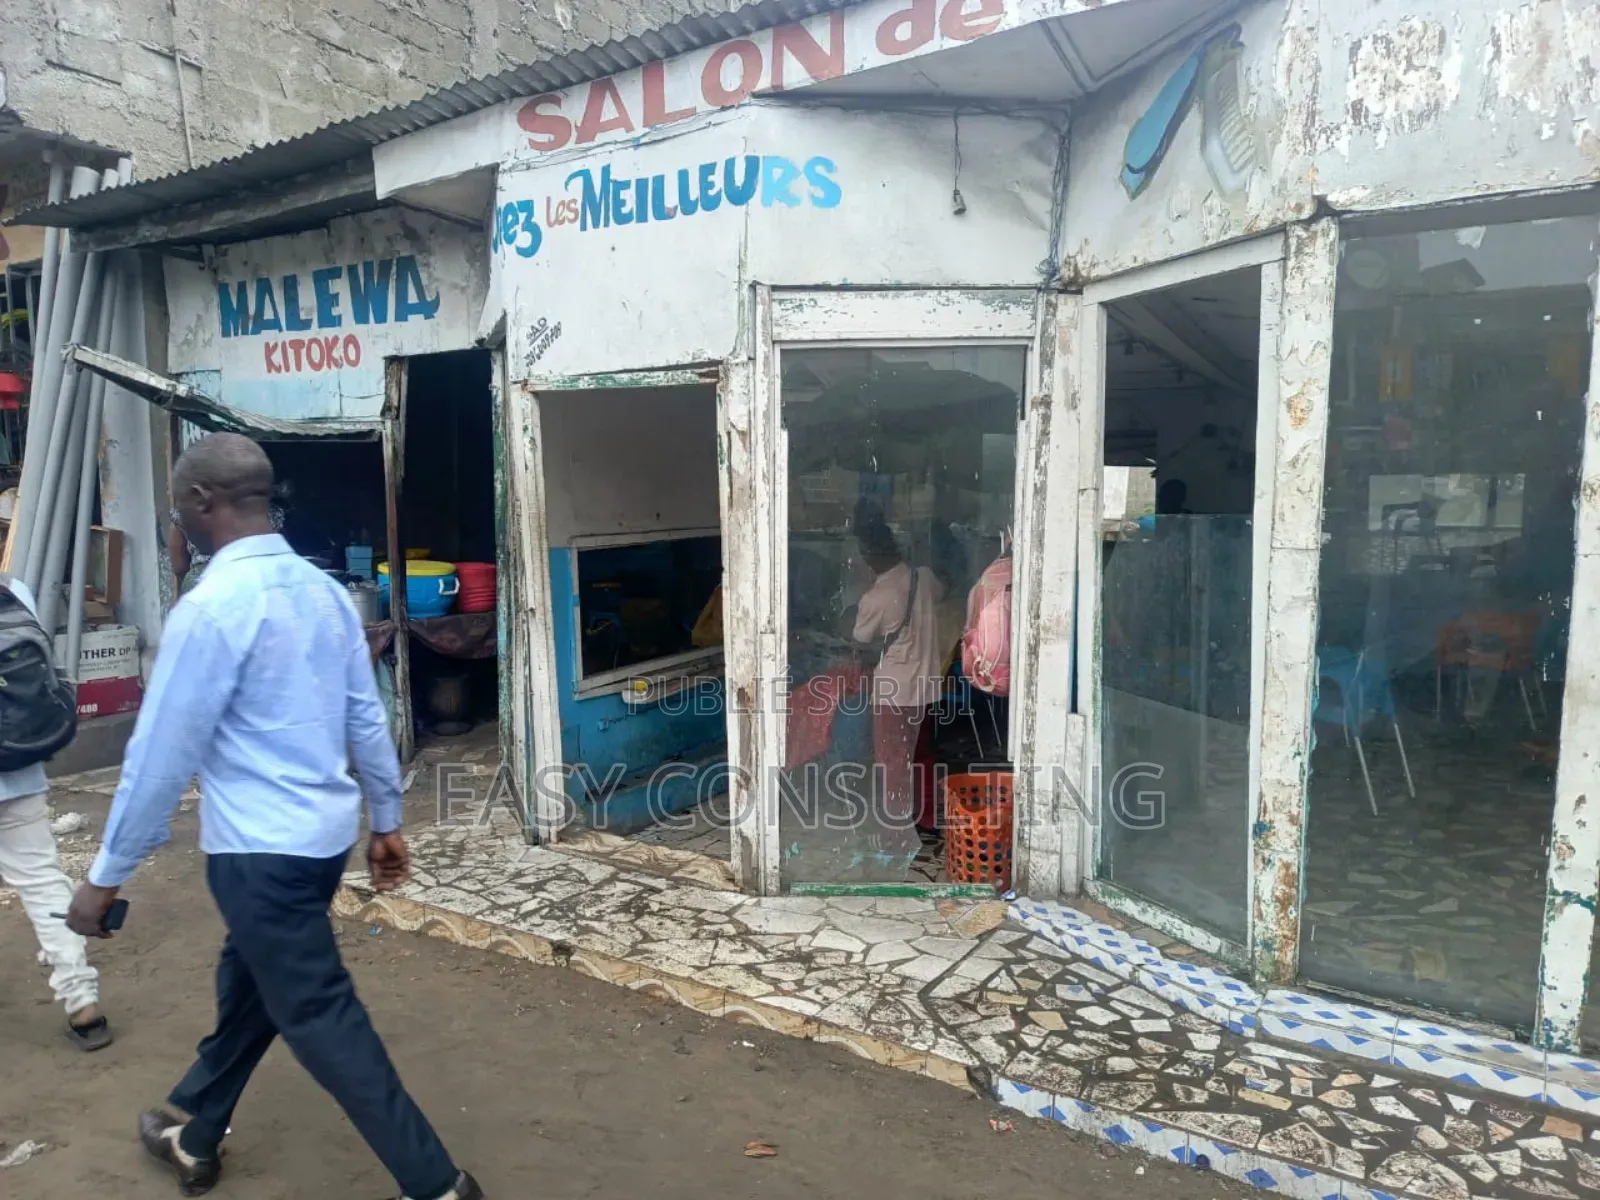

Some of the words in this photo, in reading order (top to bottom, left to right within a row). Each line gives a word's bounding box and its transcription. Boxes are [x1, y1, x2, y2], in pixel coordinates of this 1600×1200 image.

[516, 15, 845, 151] SALON
[875, 0, 1004, 56] de
[565, 154, 842, 232] MEILLEURS
[218, 254, 441, 338] MALEWA
[264, 333, 362, 374] KITOKO
